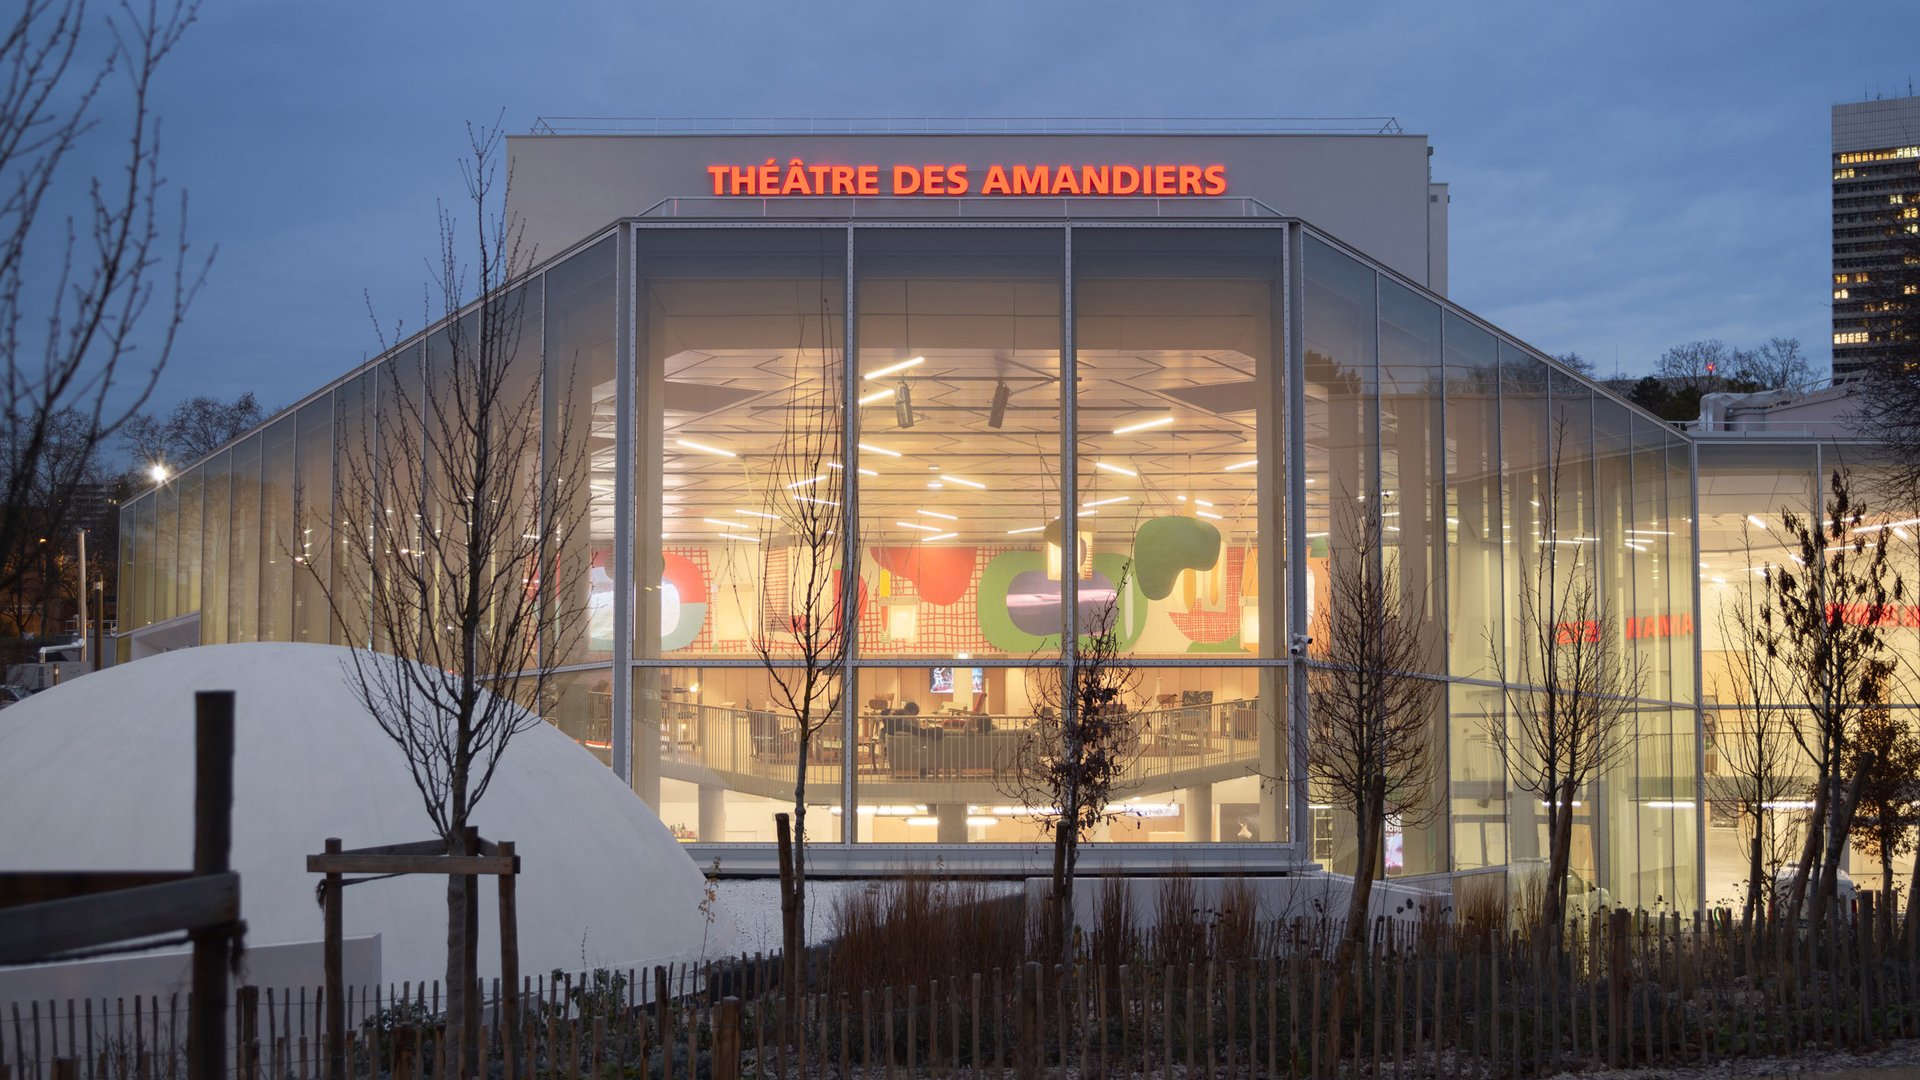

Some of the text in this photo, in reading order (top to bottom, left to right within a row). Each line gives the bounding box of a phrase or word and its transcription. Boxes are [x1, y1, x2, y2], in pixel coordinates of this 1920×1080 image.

[707, 158, 1227, 195] THÉÂTRE DES AMANDIERS
